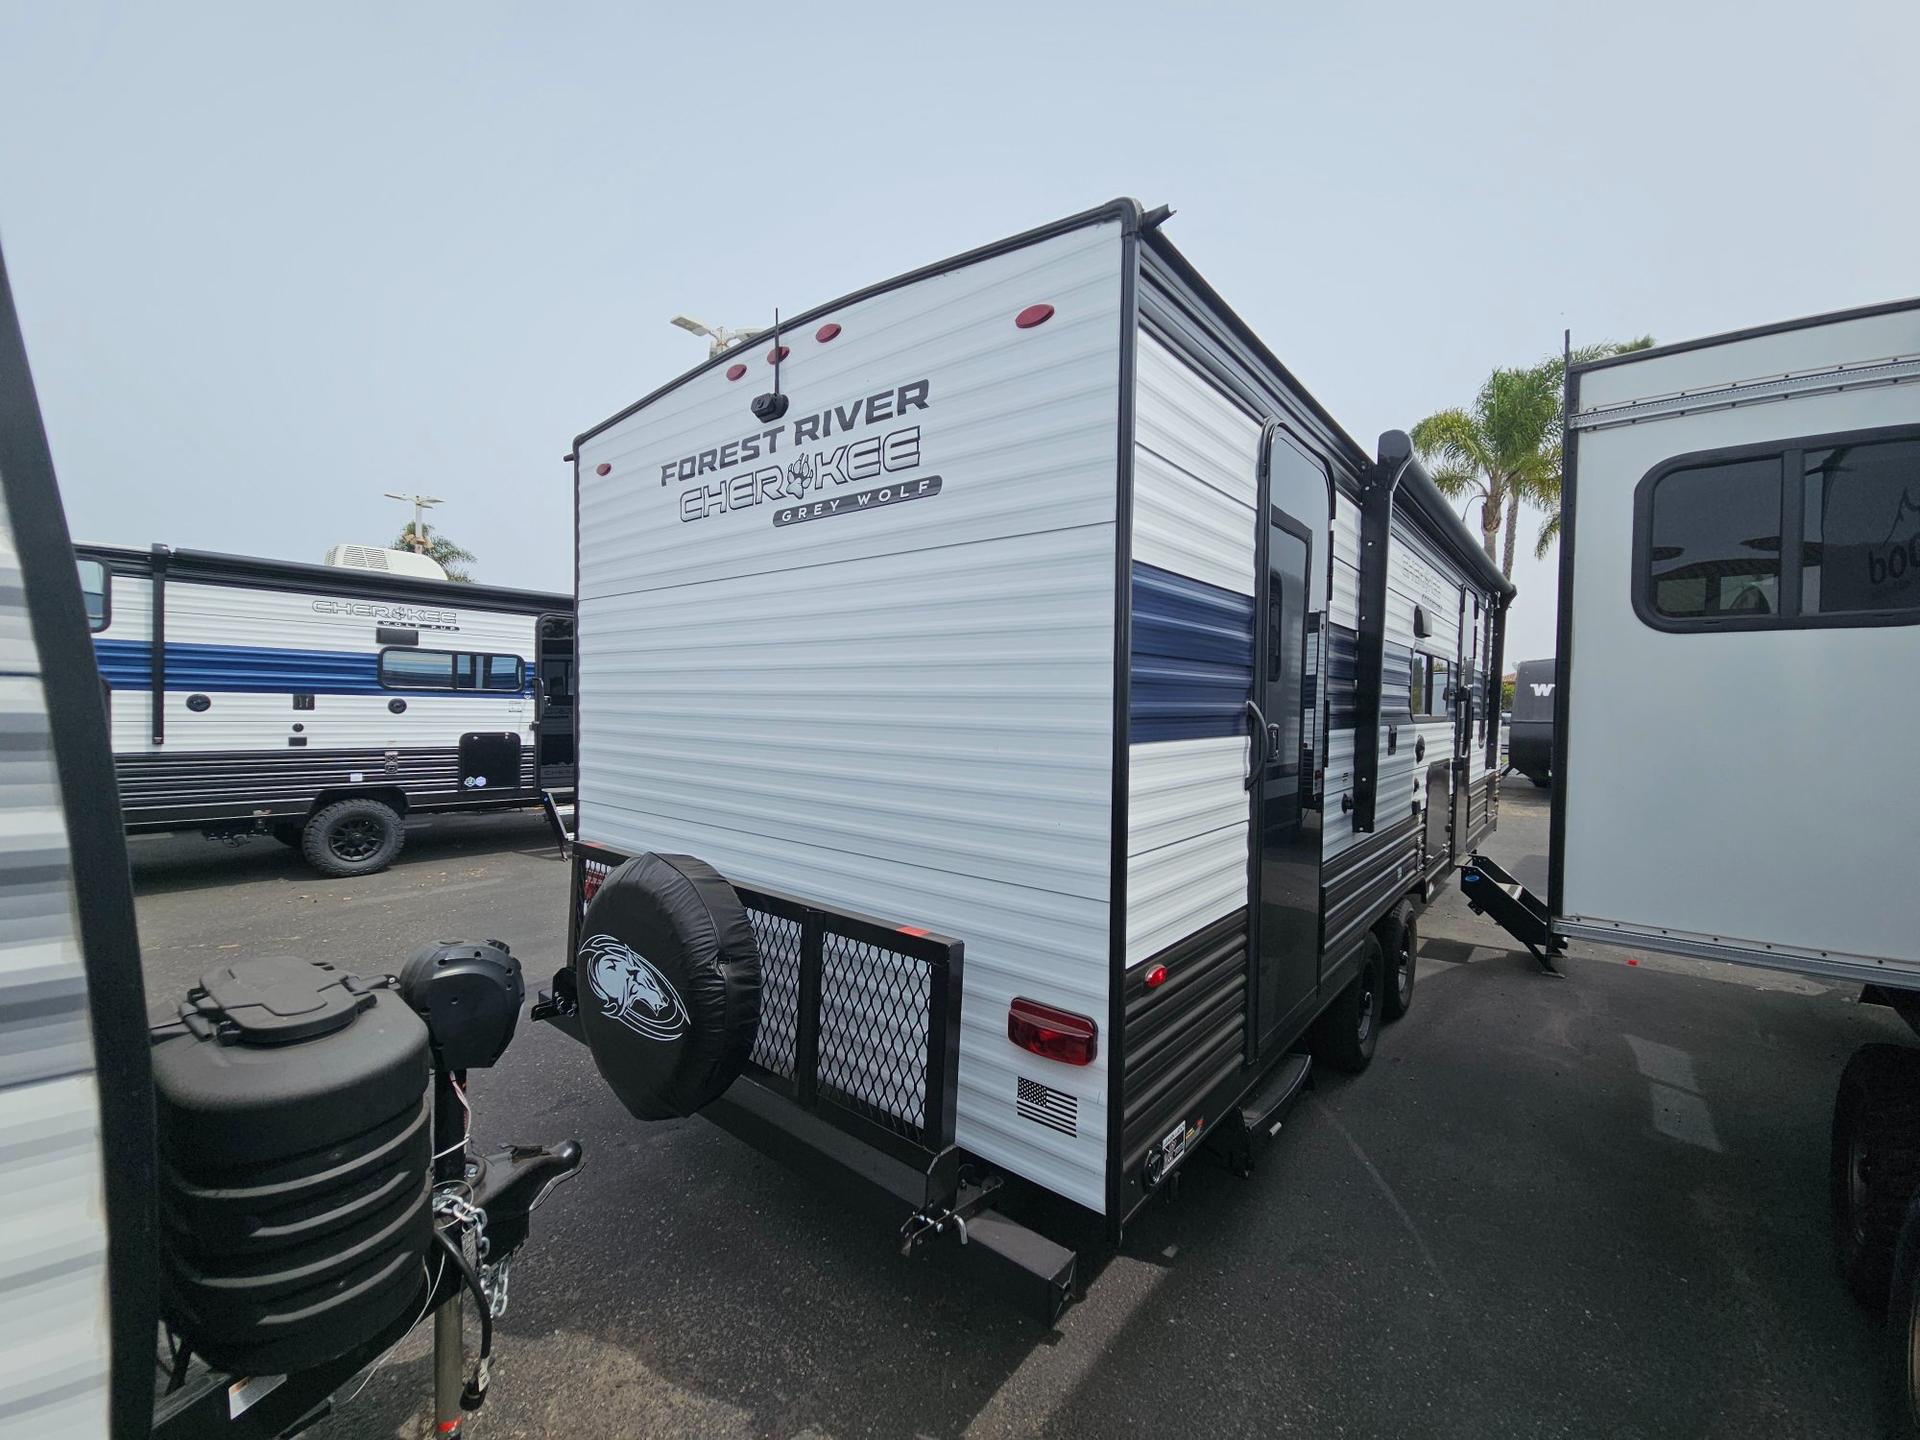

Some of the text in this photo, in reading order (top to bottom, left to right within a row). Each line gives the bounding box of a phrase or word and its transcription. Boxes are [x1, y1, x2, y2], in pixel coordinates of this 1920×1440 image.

[661, 379, 930, 487] FOREST RIVER
[680, 425, 921, 522] CHEROKEE
[782, 480, 930, 522] GREY WOLF
[312, 600, 456, 623] CHEROKEE
